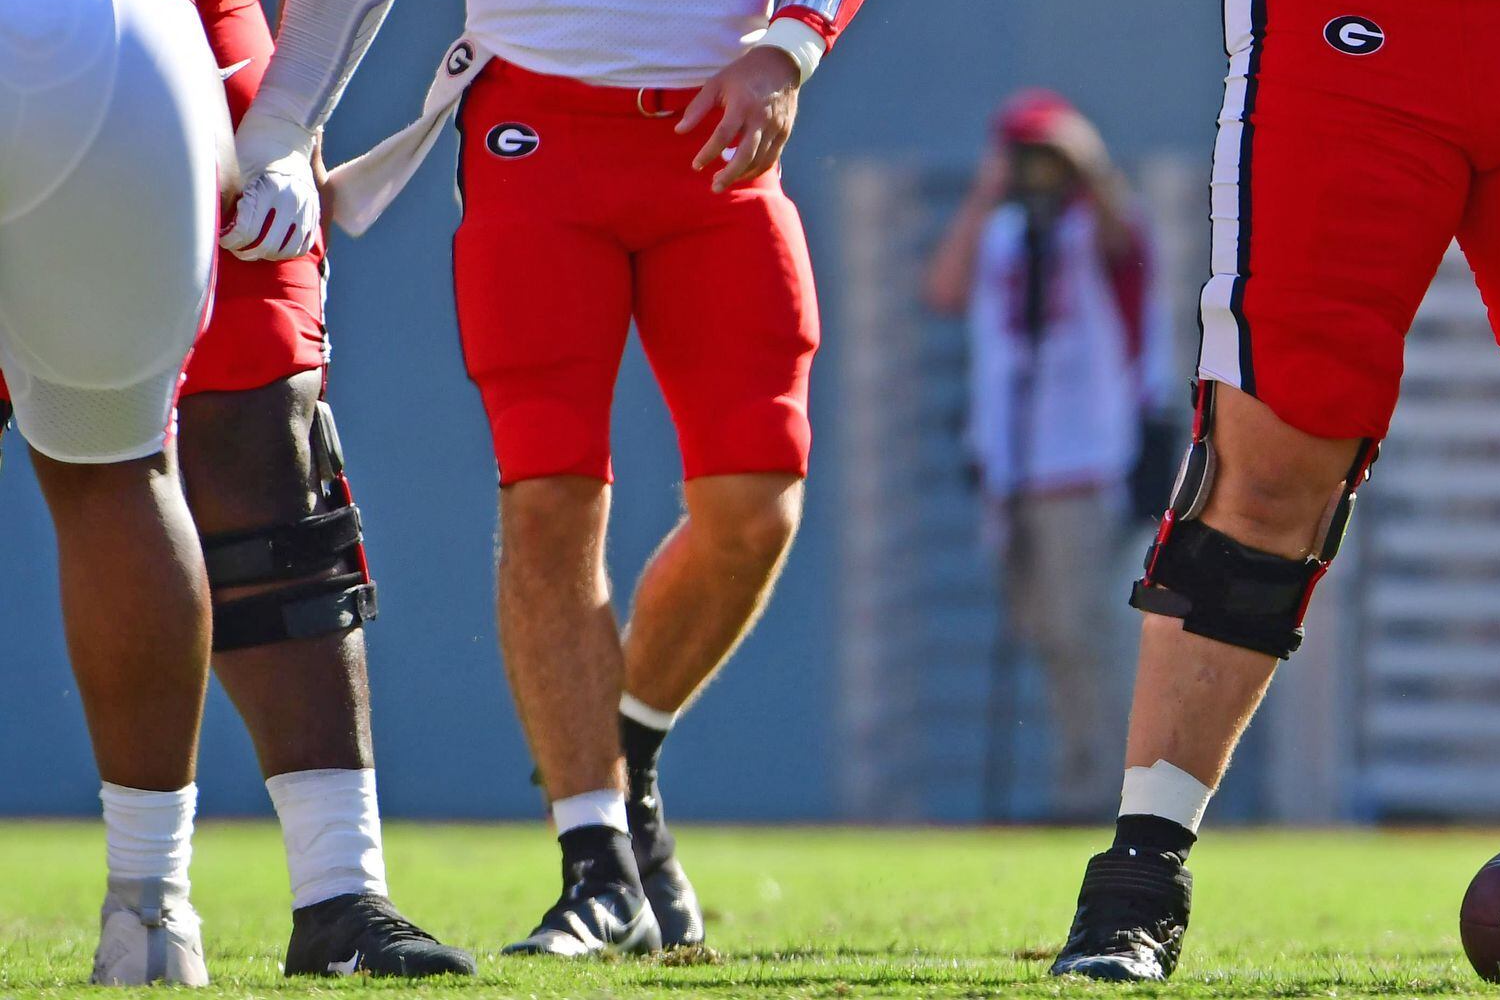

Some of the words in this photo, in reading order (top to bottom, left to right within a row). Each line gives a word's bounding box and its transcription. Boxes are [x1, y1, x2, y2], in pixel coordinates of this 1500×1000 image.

[1324, 15, 1384, 55] G
[447, 41, 474, 76] G
[486, 122, 539, 158] G
